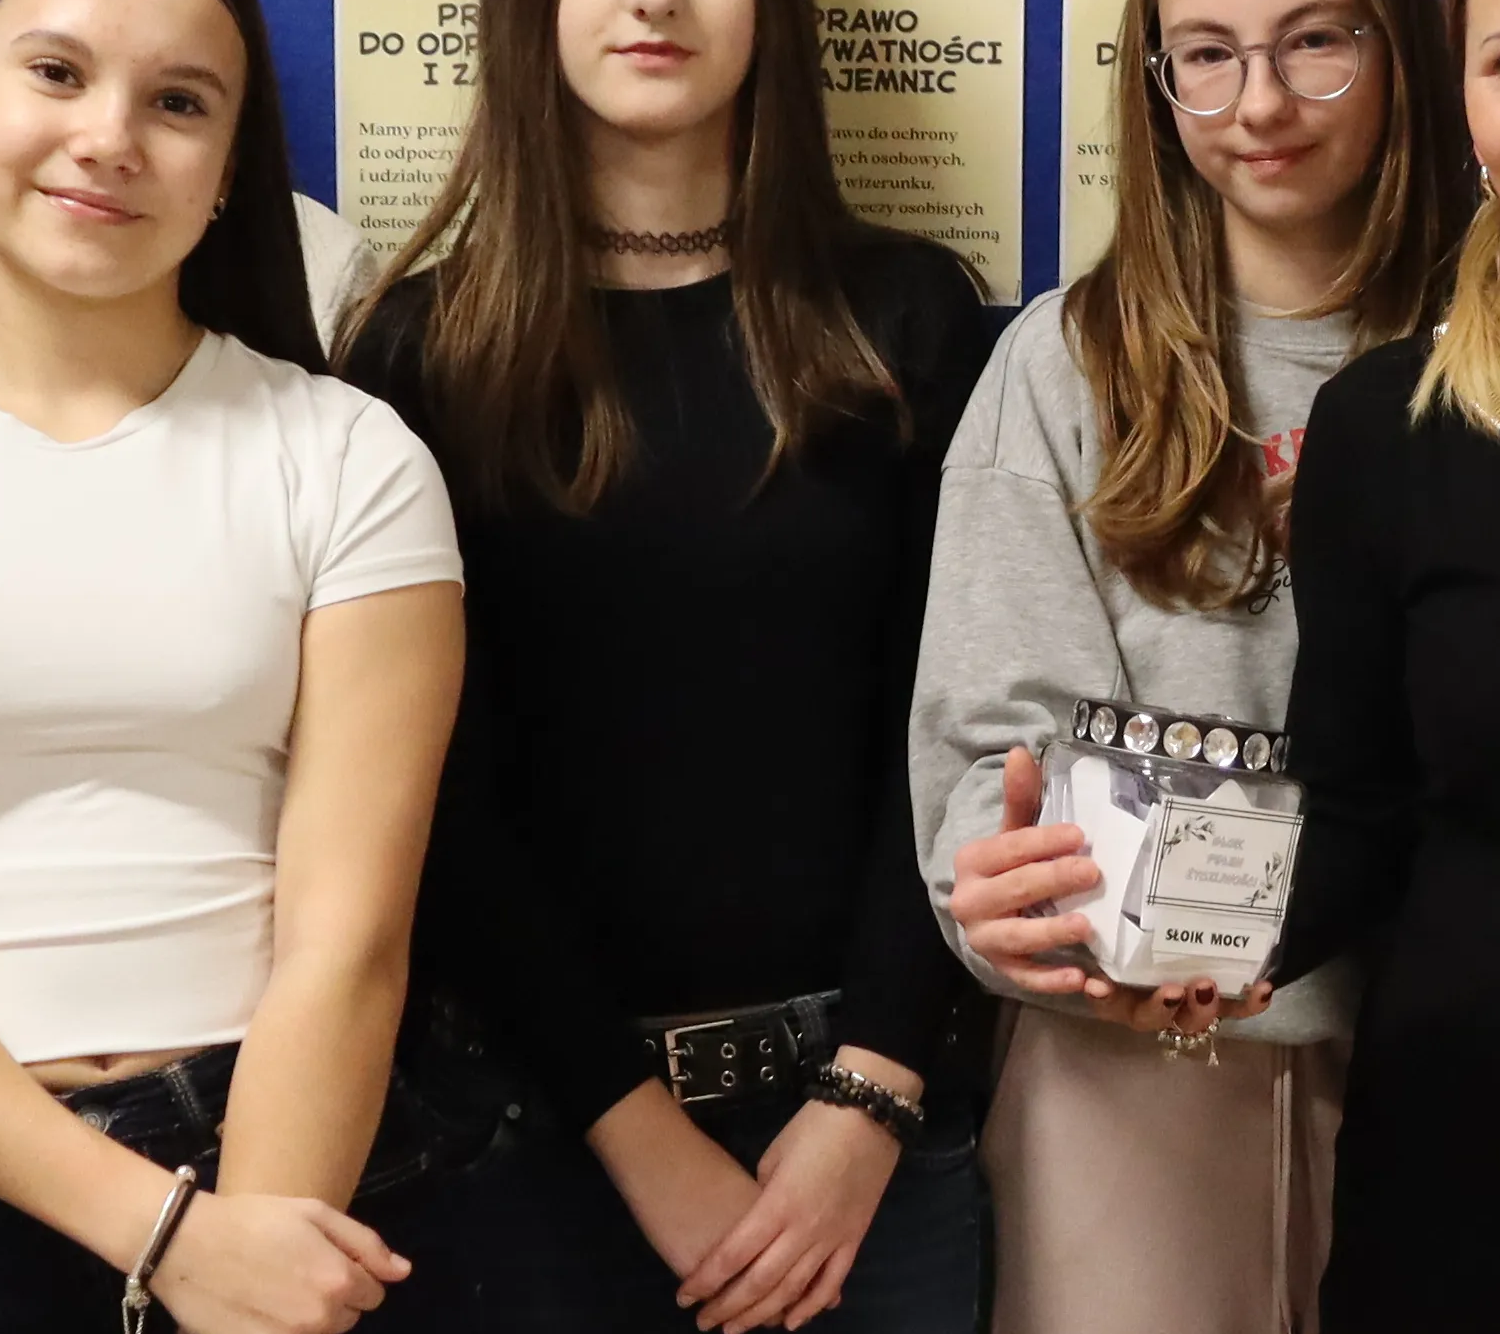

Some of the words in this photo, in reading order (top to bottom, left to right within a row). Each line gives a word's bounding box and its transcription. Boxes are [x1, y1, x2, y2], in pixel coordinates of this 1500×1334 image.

[359, 32, 404, 55] DO
[423, 62, 438, 85] I
[821, 68, 956, 93] AJEMNIC
[359, 123, 411, 139] Mamy
[417, 126, 460, 140] praw
[868, 127, 888, 140] do
[891, 128, 958, 143] ochrony
[359, 146, 380, 159] do
[384, 146, 454, 162] odpoczy
[360, 195, 398, 206] oraz
[899, 202, 984, 218] osobistych
[1165, 928, 1204, 944] SŁOIK
[1210, 933, 1250, 948] MOCY
